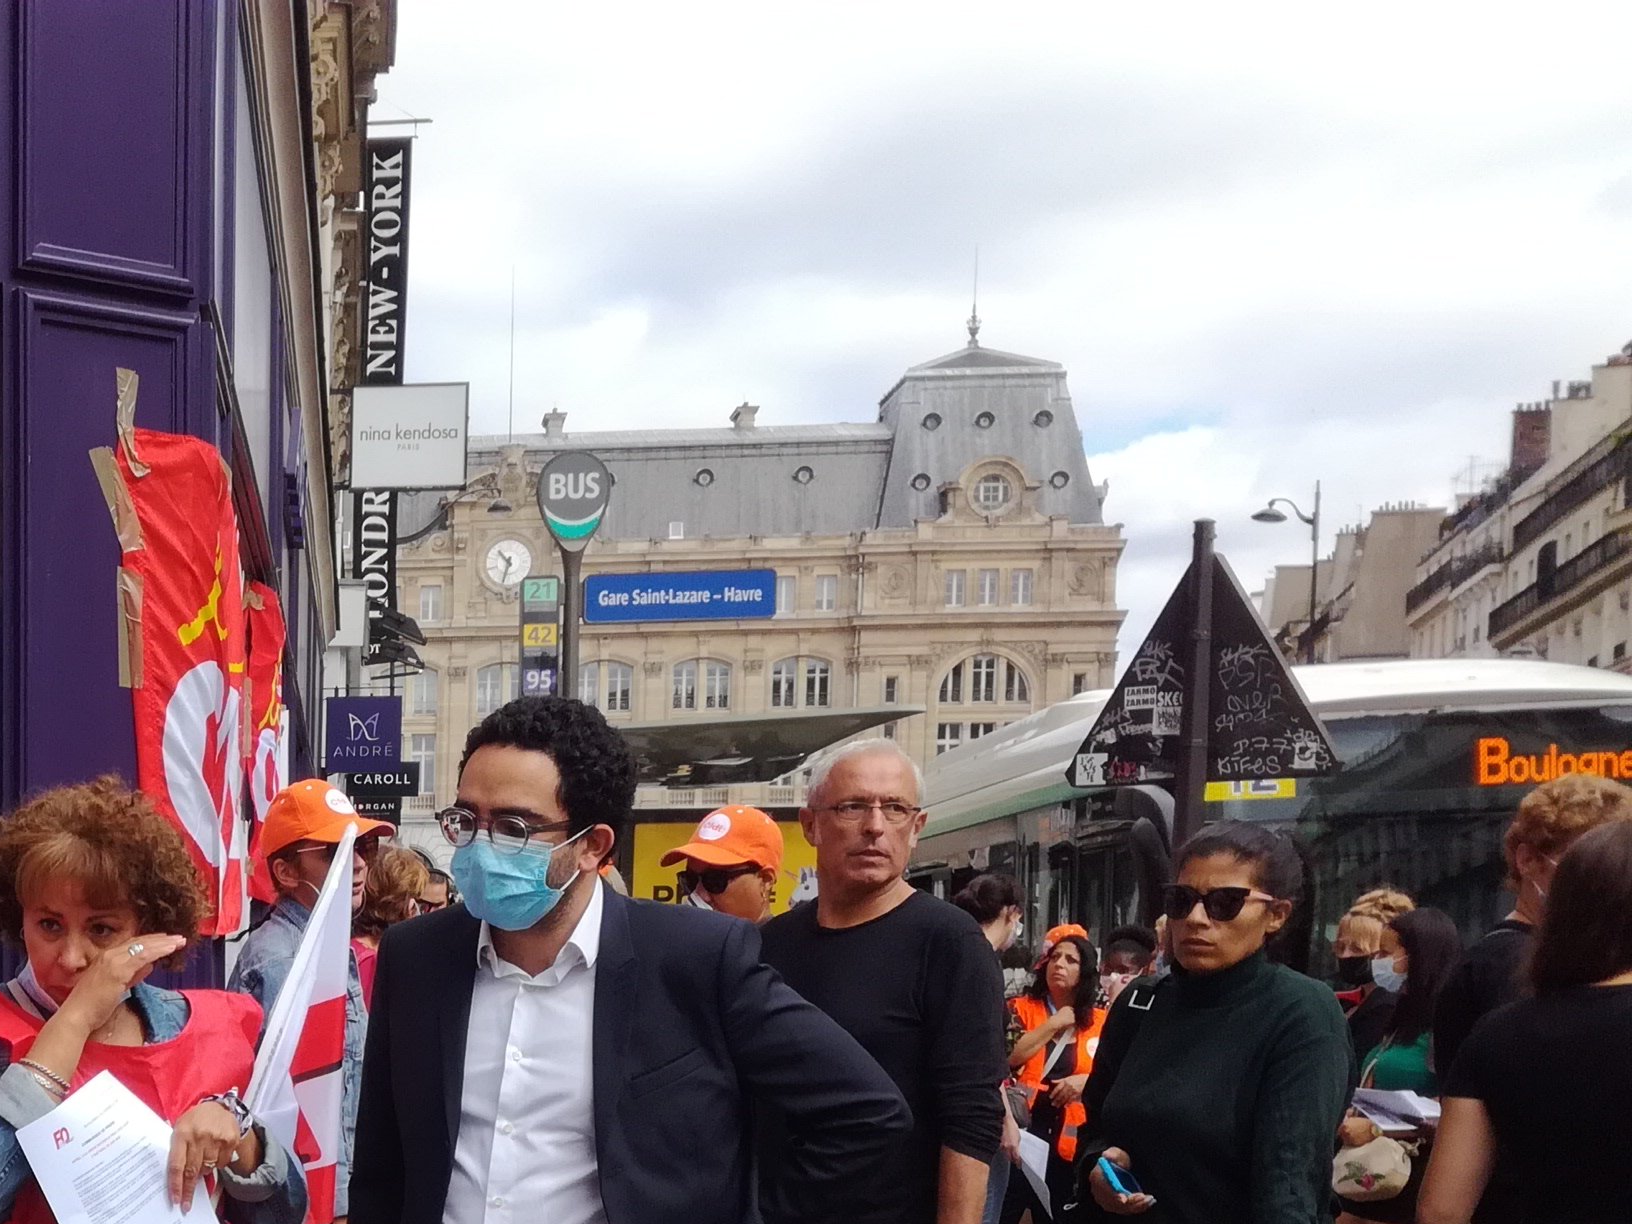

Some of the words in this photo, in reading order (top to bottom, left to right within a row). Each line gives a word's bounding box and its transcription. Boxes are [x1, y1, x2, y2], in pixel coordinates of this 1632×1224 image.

[366, 149, 404, 377] NEW-YORK
[360, 426, 391, 441] nina
[395, 421, 459, 441] kendosa
[397, 443, 420, 451] PARIS
[549, 472, 600, 500] BUS
[529, 581, 552, 600] 21
[598, 590, 629, 606] Gare
[632, 588, 711, 606] Saint-Lazare
[724, 586, 763, 603] Havre
[528, 625, 552, 644] 42
[526, 668, 552, 690] 95
[333, 741, 393, 758] ANDRÉ
[1479, 737, 1632, 785] Boulogne
[353, 773, 411, 785] CAROLL
